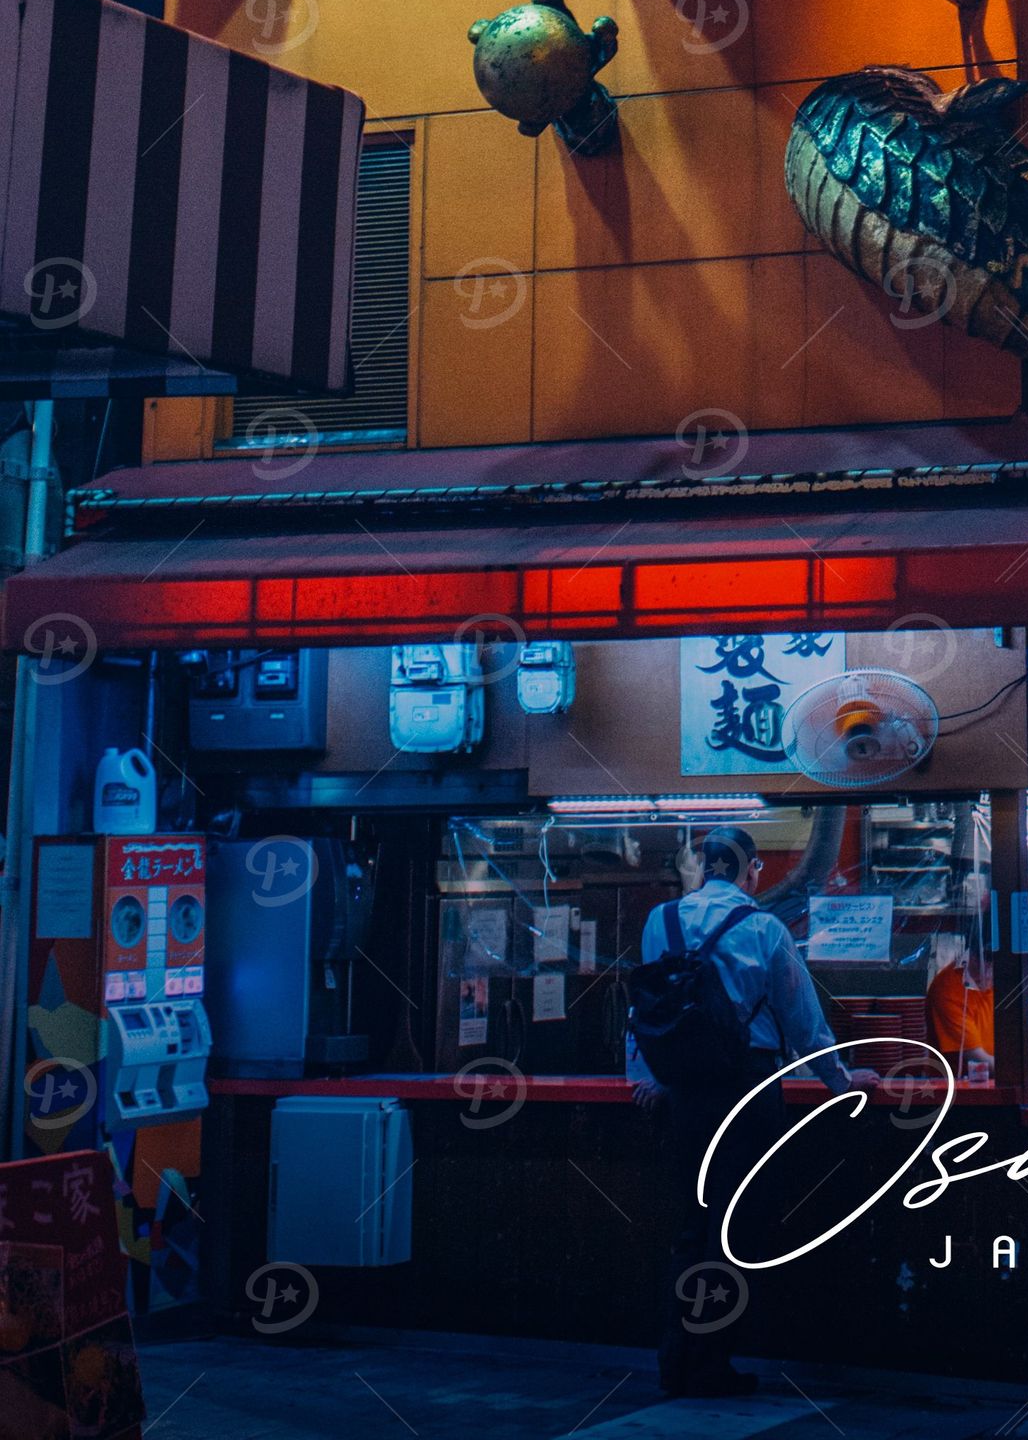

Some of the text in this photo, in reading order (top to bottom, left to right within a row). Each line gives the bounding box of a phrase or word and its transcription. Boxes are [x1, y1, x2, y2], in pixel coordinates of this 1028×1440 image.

[121, 856, 194, 881] 金龍ラーメン
